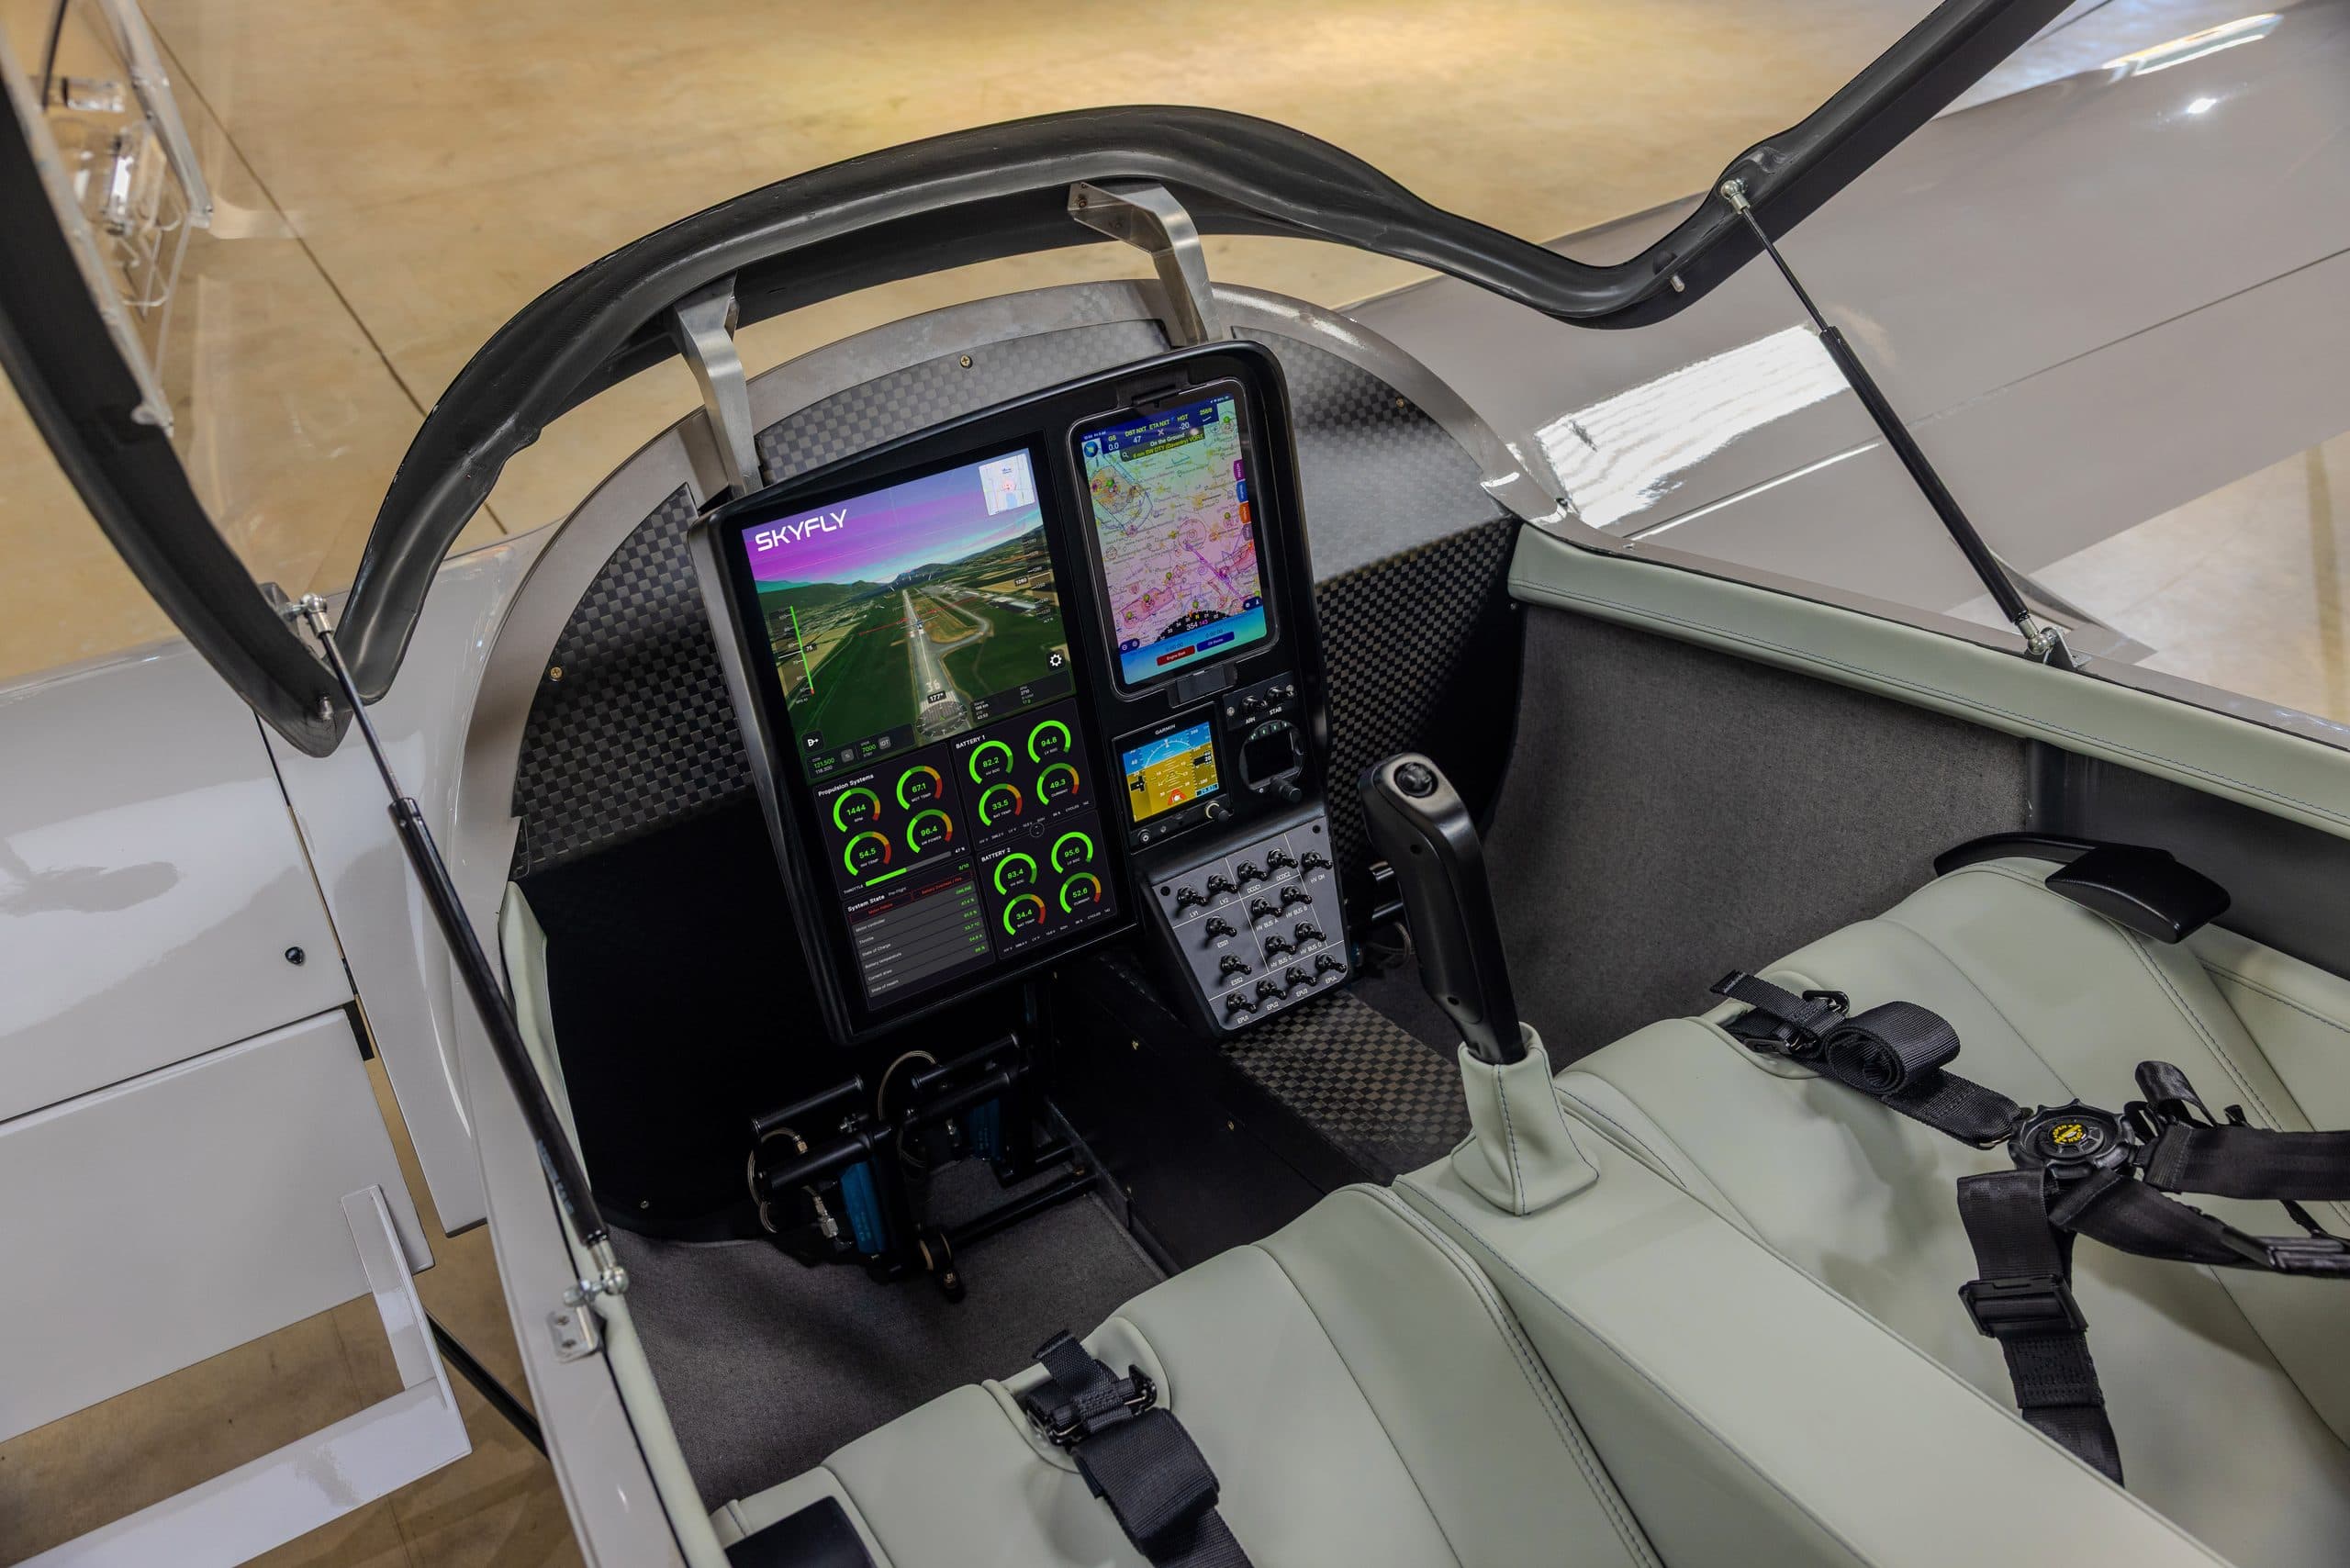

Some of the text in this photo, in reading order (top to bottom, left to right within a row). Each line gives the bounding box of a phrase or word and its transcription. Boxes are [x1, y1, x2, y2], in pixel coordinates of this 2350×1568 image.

[1133, 435, 1142, 443] 47
[1109, 442, 1119, 451] 0.0
[755, 510, 846, 552] SKYFLY
[1187, 622, 1198, 631] 354
[1270, 707, 1281, 715] STAB
[1155, 723, 1175, 735] GARMIN
[956, 736, 981, 749] BATTERY
[862, 745, 876, 754] 7000
[982, 756, 999, 767] 82.2
[818, 774, 874, 797] Propulsion Systems
[1050, 778, 1066, 790] 49.3
[846, 804, 867, 815] 1444
[992, 799, 1009, 810] 33.5
[859, 847, 876, 858] 54.5
[981, 849, 1006, 863] BATTERY
[1007, 868, 1024, 879] 83.4
[848, 902, 868, 912] System
[869, 895, 885, 903] State
[1016, 909, 1033, 920] 34.4
[1293, 907, 1303, 916] BUS
[1263, 919, 1273, 928] BUS
[1308, 944, 1316, 952] BUS
[1278, 956, 1288, 964] BUS
